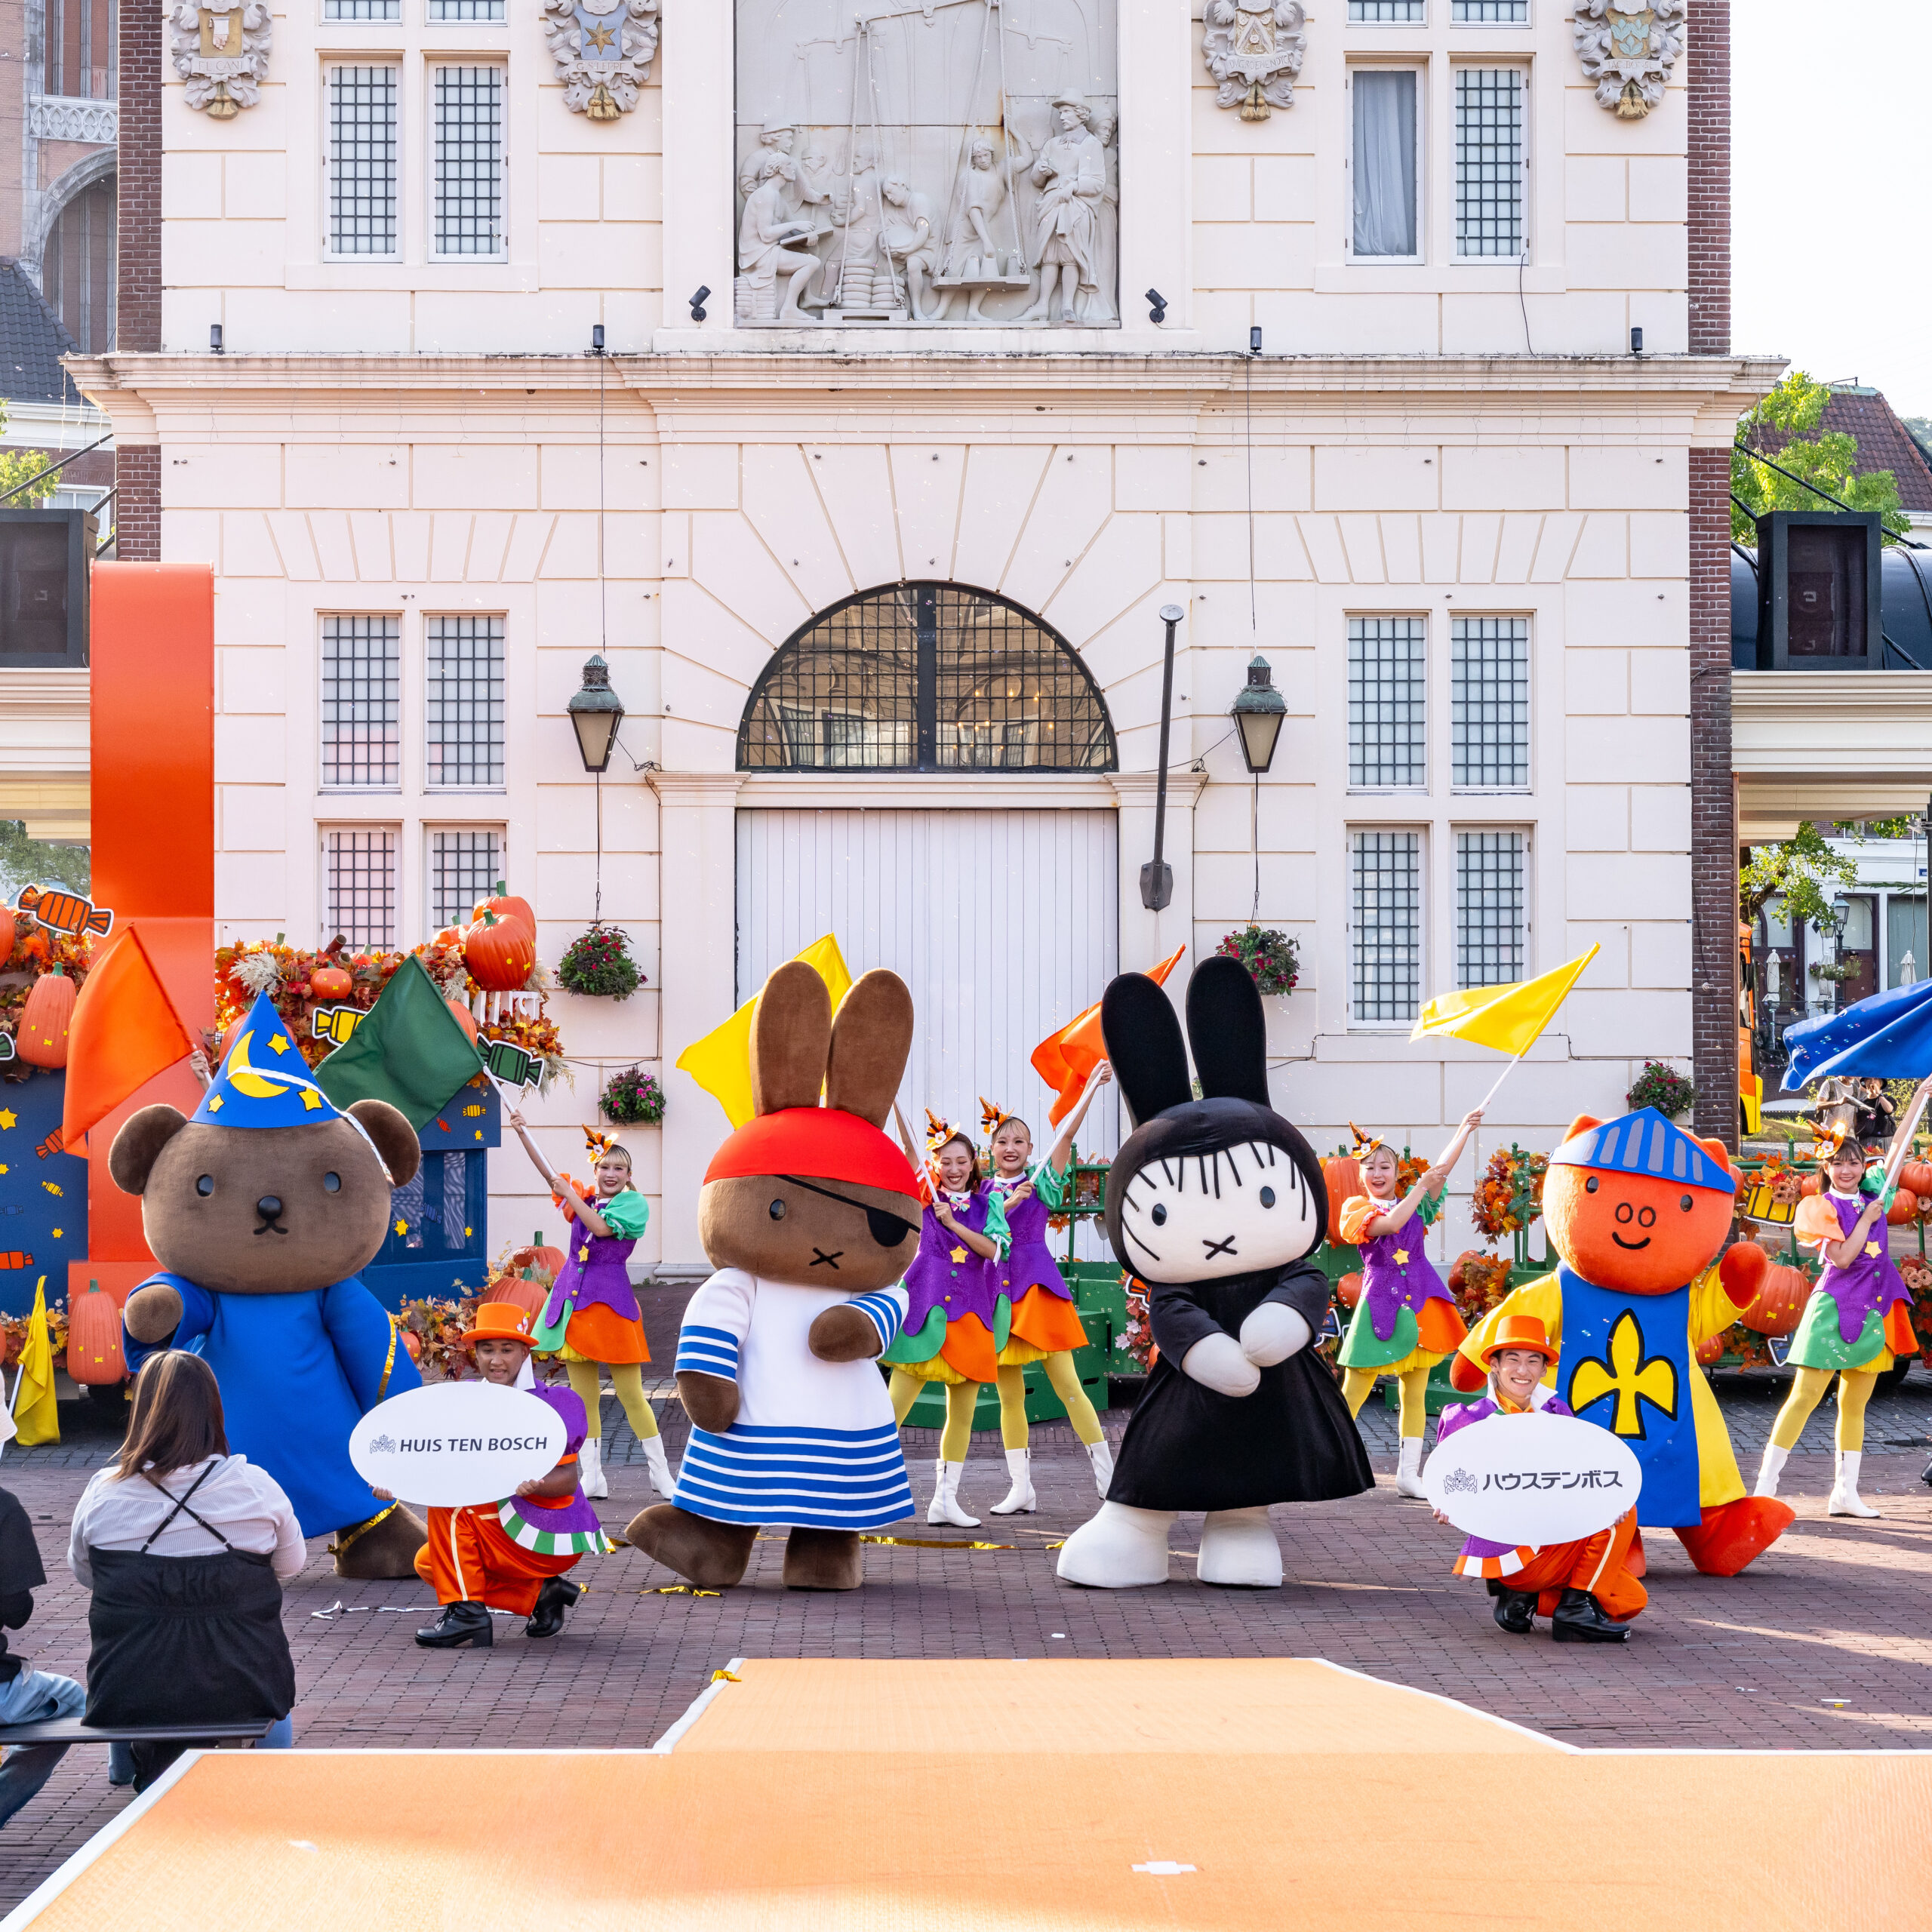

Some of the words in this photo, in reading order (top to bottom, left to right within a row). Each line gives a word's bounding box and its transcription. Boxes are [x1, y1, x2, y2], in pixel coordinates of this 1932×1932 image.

[400, 1438, 442, 1452] HUIS
[448, 1438, 482, 1452] TEN
[488, 1436, 547, 1451] BOSCH
[1483, 1469, 1623, 1491] ハウステンボス
